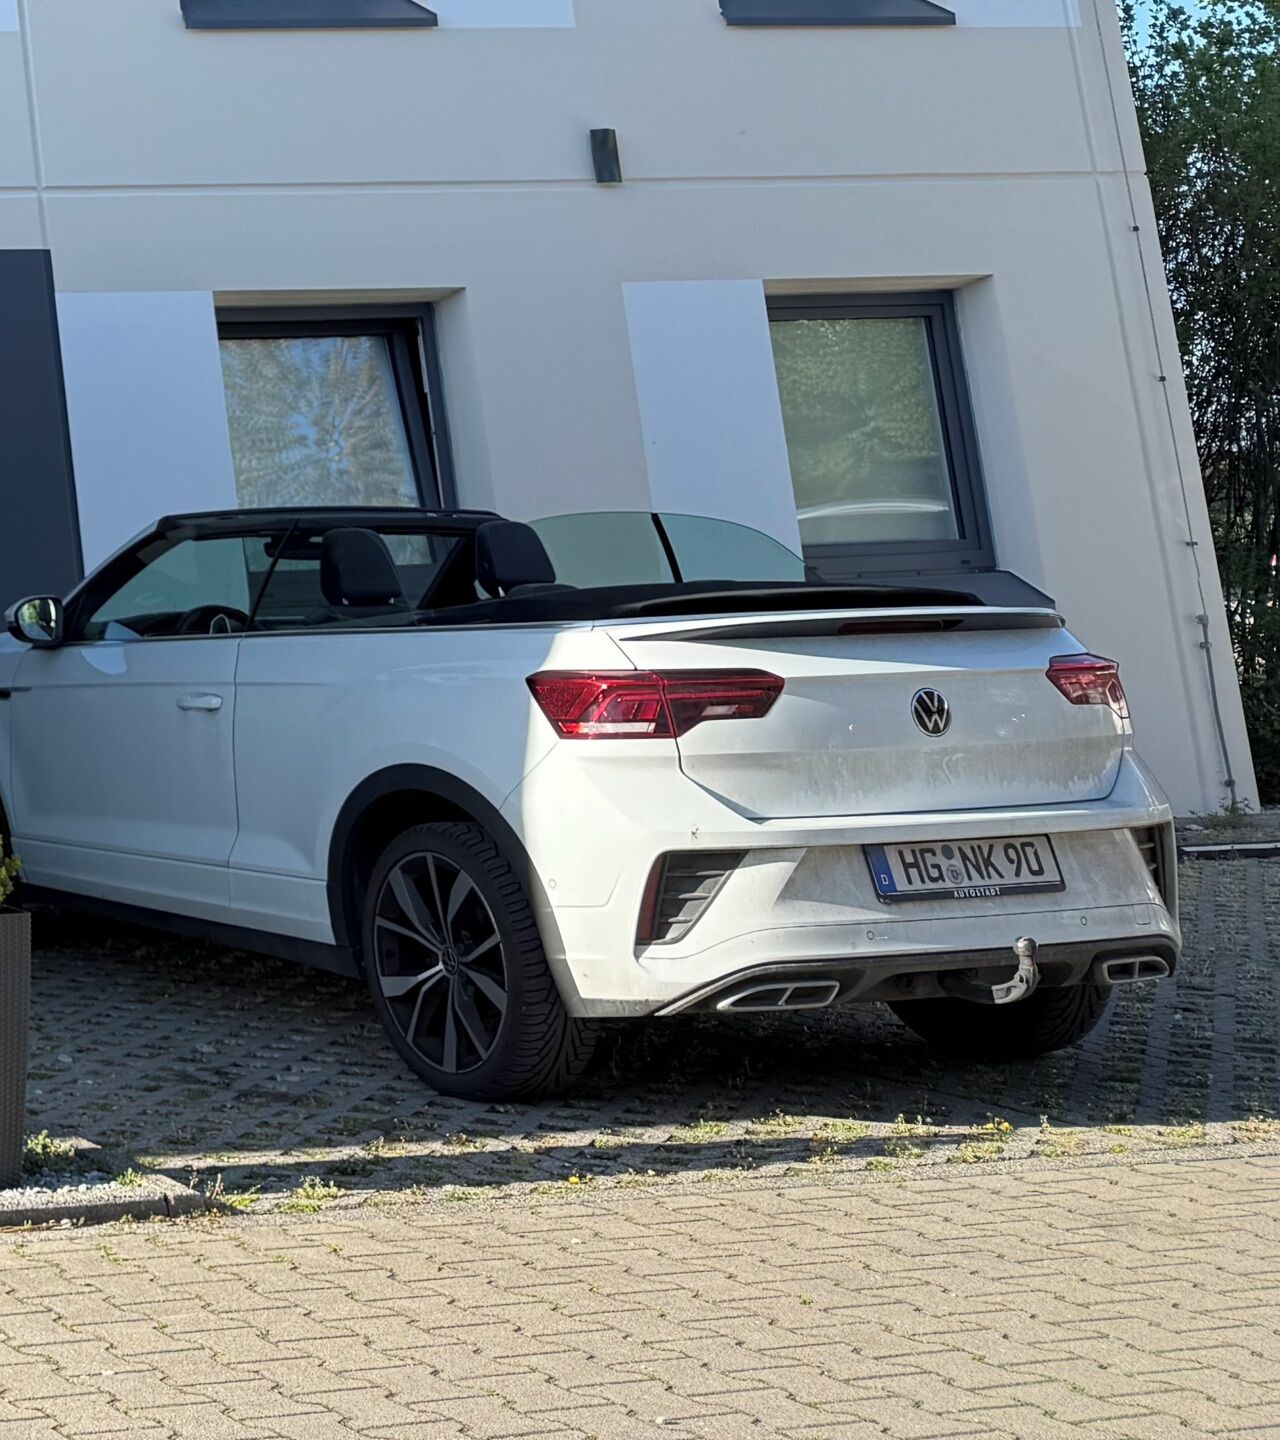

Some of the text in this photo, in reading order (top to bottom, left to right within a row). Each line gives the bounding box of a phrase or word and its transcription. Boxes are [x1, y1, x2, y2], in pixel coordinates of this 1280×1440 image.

[897, 847, 945, 886] HG
[957, 843, 1005, 881] NK
[1003, 841, 1045, 878] 90
